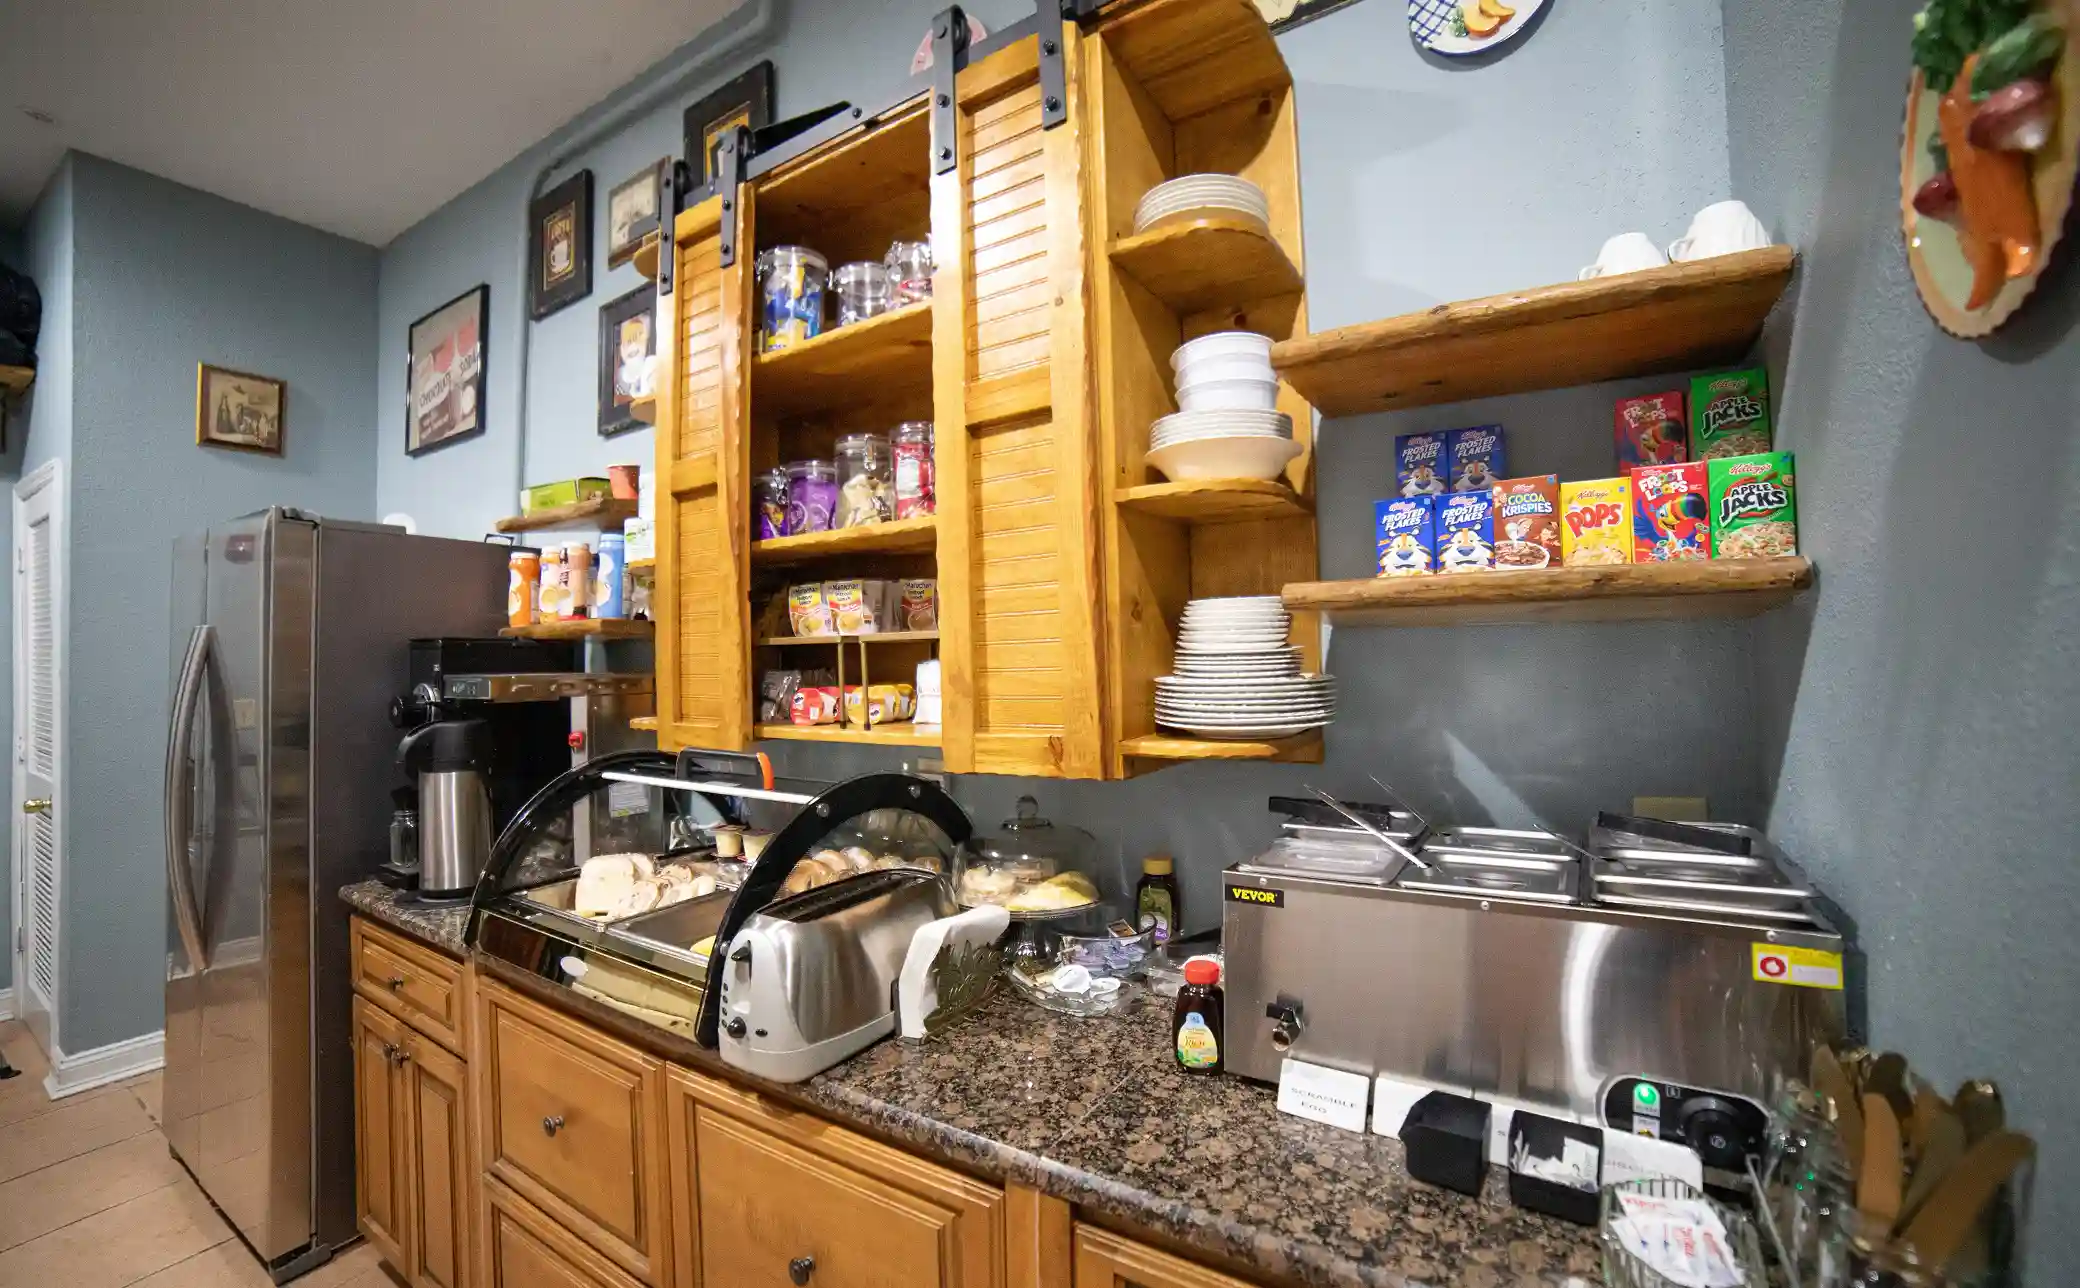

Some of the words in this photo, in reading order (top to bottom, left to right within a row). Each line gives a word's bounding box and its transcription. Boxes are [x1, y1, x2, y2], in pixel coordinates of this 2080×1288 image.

[1711, 396, 1748, 411] APPLE
[1701, 402, 1762, 439] JACKS
[1402, 442, 1441, 458] FROSTED
[1455, 436, 1496, 452] FROSTED
[1458, 444, 1493, 458] FLAKES
[1404, 450, 1438, 463] FLAKES
[1638, 468, 1685, 492] FROOT
[1644, 480, 1689, 501] LOOPS
[1732, 482, 1773, 498] APPLE
[1508, 493, 1546, 506] COCOA
[1382, 507, 1426, 525] FROSTED
[1442, 502, 1488, 519] FROSTED
[1502, 502, 1553, 518] KRISPIES
[1719, 490, 1788, 528] JACKS
[1385, 516, 1422, 532] FLAKES
[1445, 511, 1484, 526] FLAKES
[1564, 503, 1623, 539] POPS
[1232, 888, 1276, 904] VEVOR
